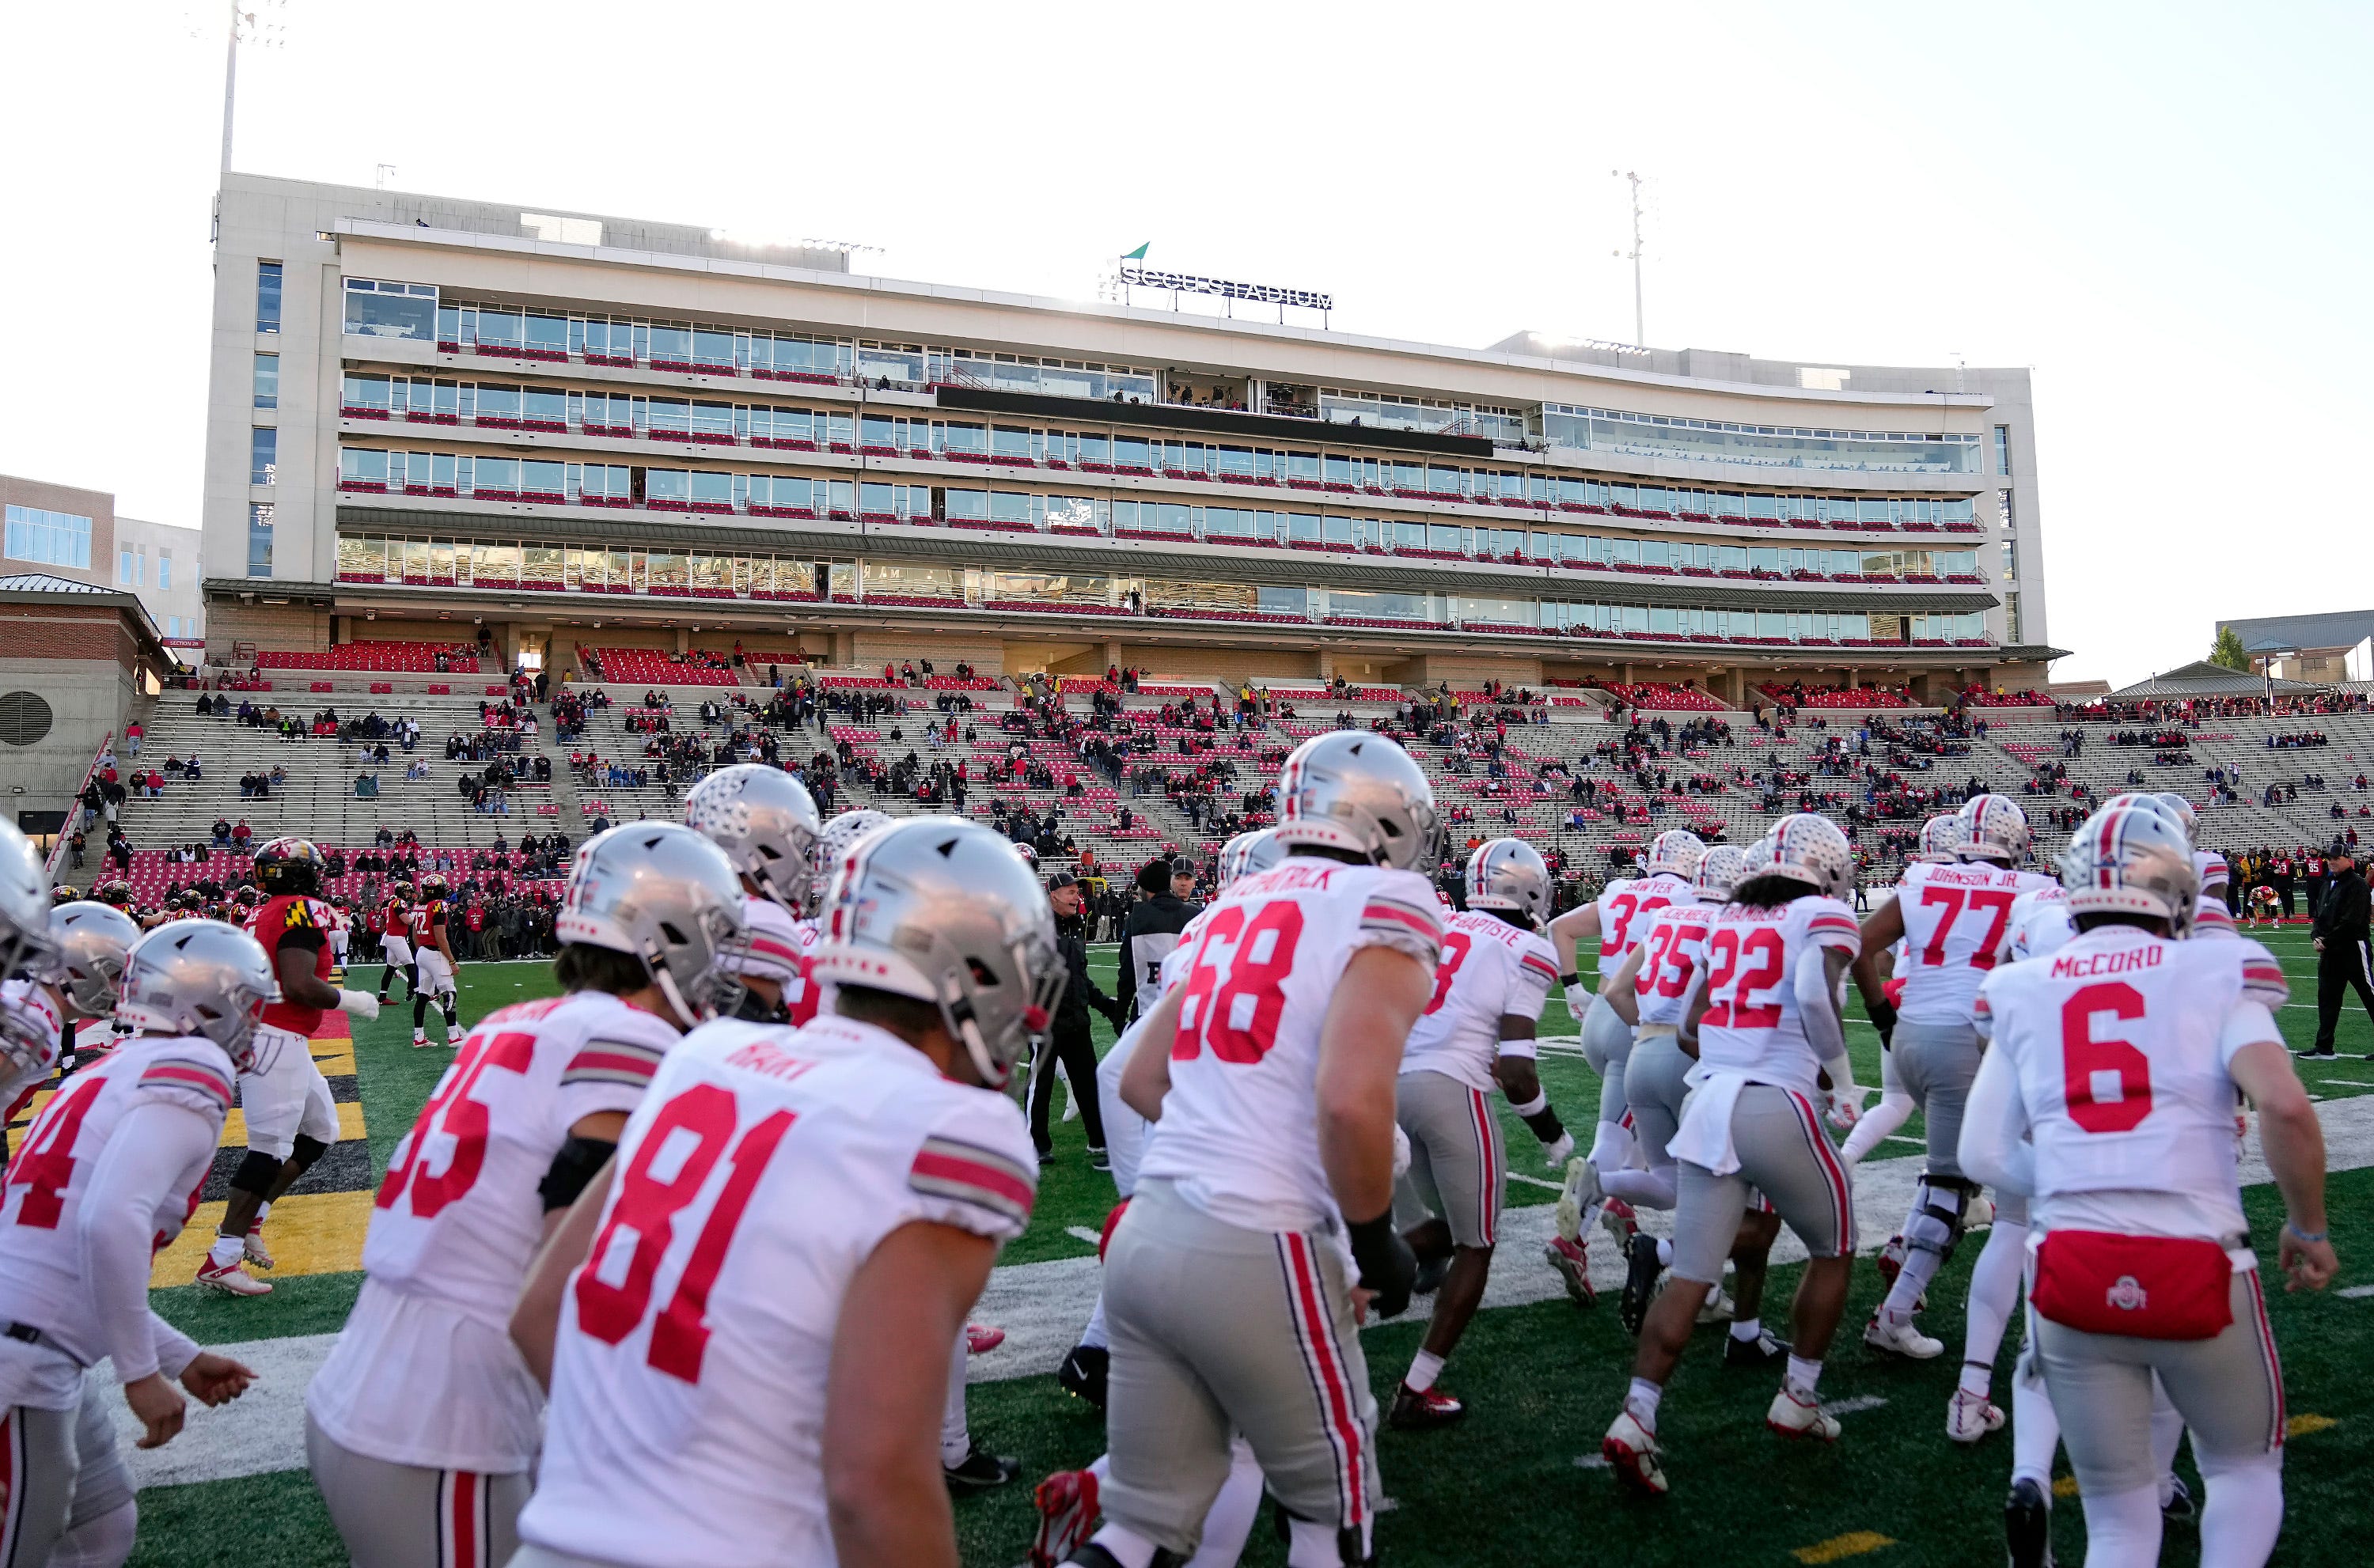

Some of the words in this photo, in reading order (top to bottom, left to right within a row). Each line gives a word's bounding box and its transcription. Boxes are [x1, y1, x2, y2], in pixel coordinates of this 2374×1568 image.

[1208, 278, 1334, 309] STADIUM
[1625, 880, 1676, 895] SAWYER
[1925, 867, 1993, 887] JOHNSON
[2308, 862, 2319, 873] 85
[1634, 924, 1708, 998] 35
[1920, 885, 2016, 971] 77
[1170, 899, 1305, 1065] 68
[1697, 927, 1784, 1029] 22
[2061, 980, 2154, 1134] 6
[575, 1081, 799, 1386] 81
